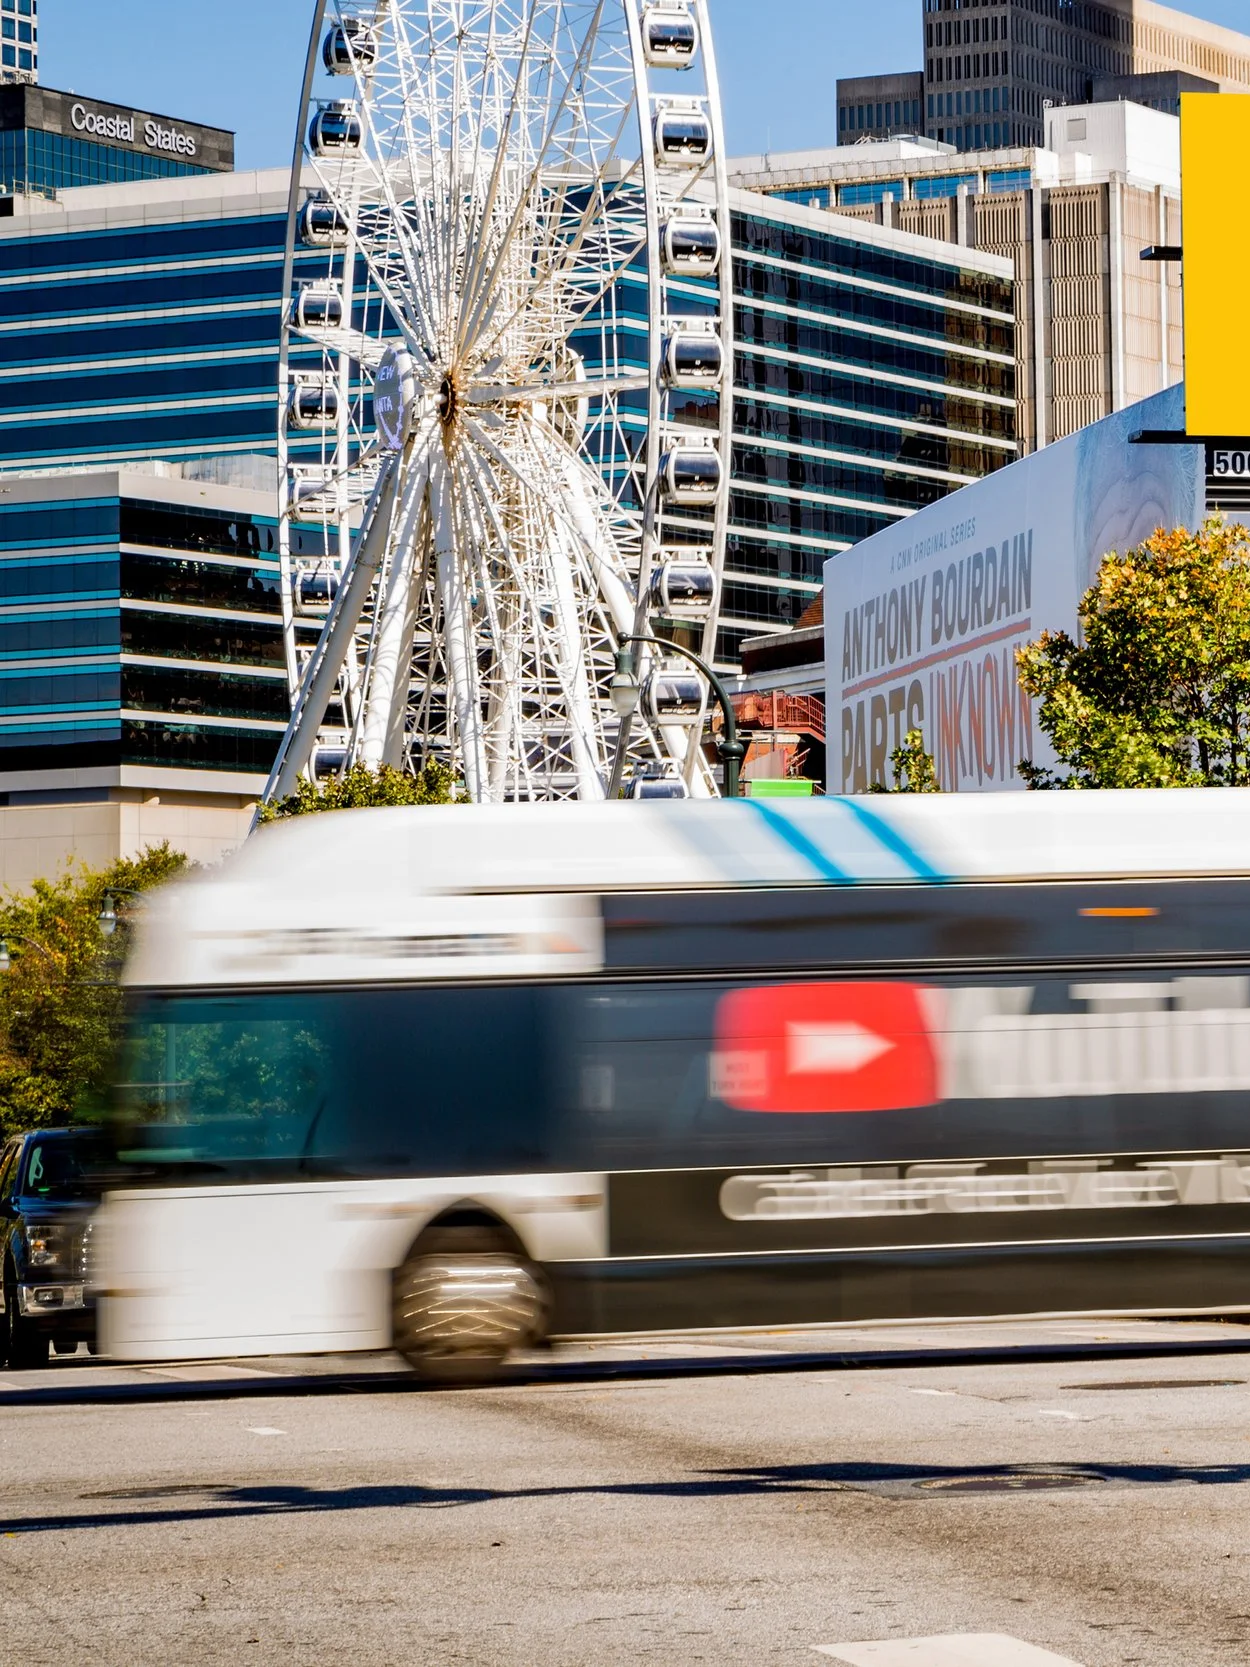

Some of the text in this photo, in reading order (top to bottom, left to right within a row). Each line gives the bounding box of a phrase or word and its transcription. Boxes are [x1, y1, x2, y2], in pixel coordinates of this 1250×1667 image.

[71, 103, 196, 156] Coastal States
[896, 549, 912, 571] CNN
[914, 535, 947, 563] ORIGINAL
[950, 516, 976, 544] SERIES
[842, 528, 1033, 683] ANTHONY BOURDAIN
